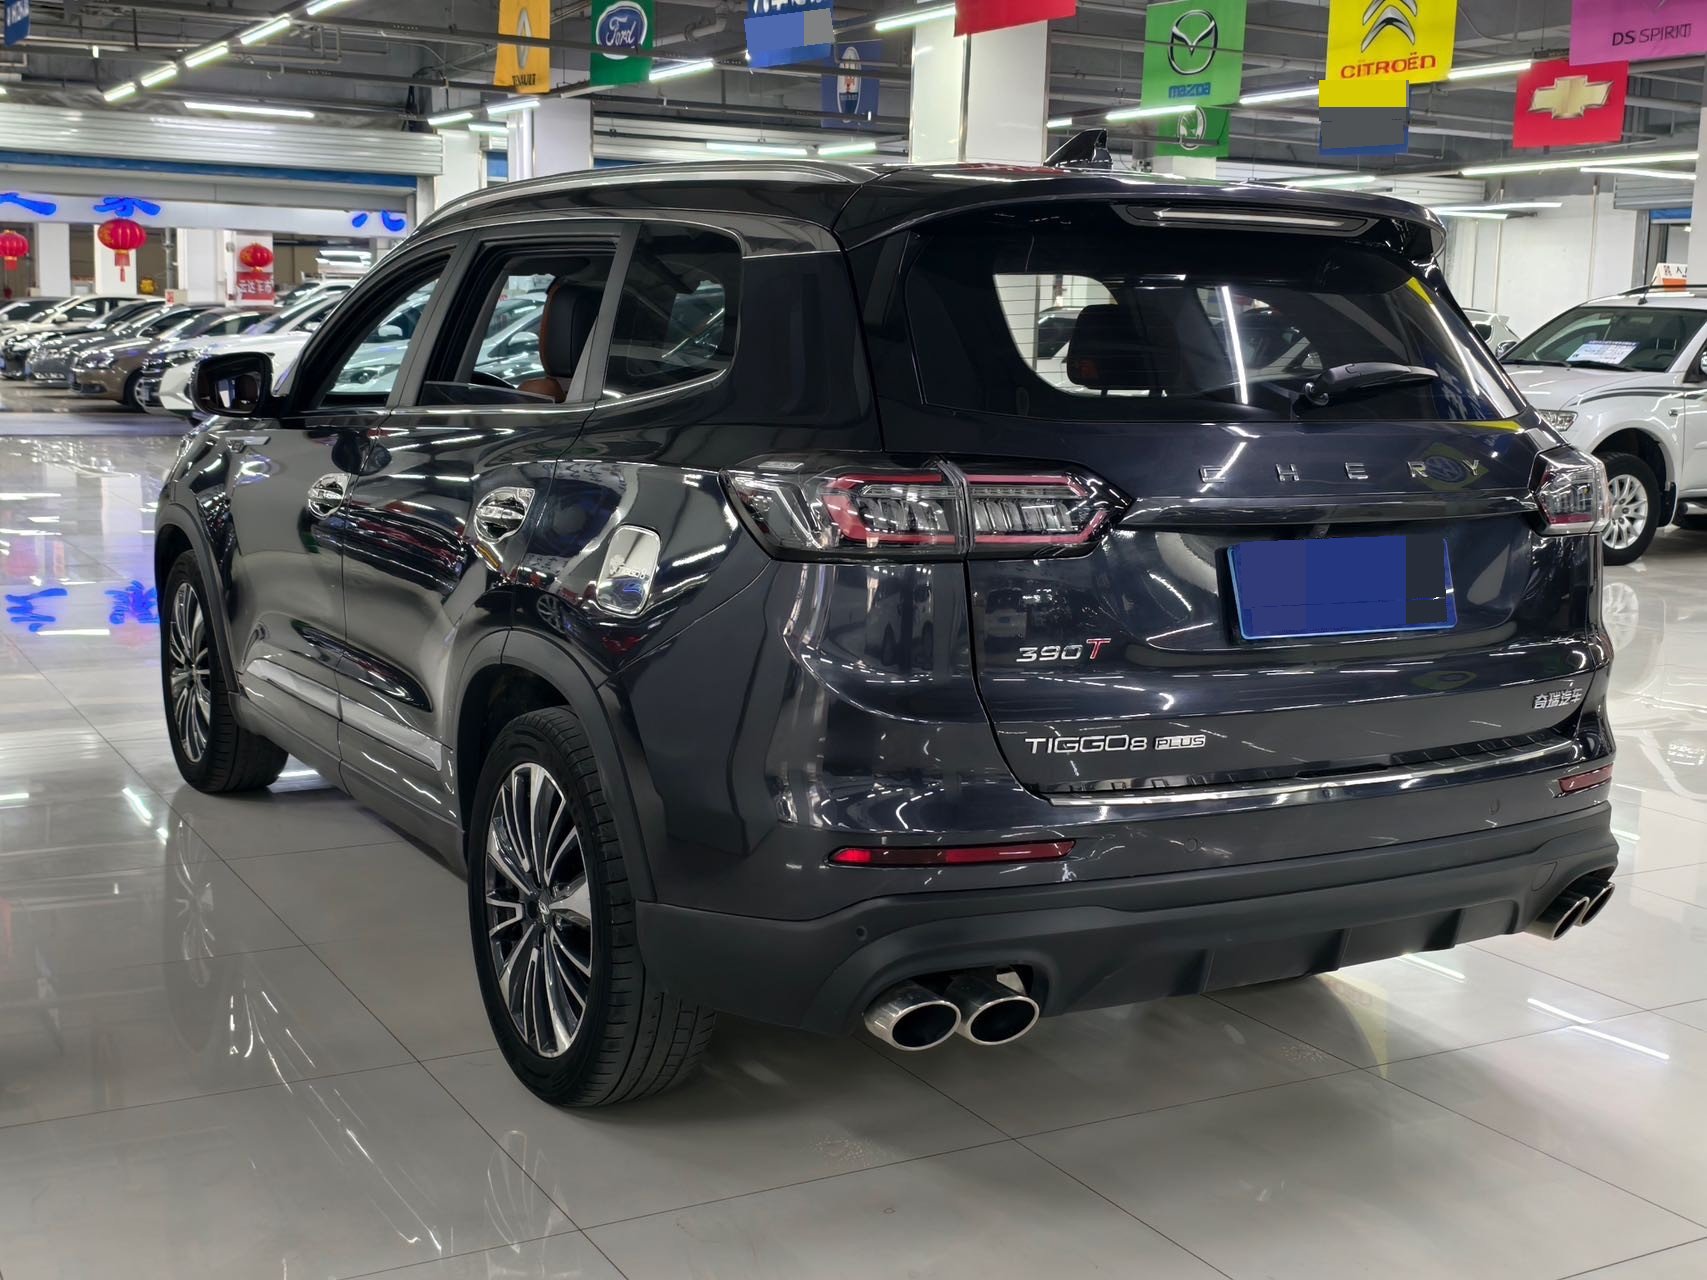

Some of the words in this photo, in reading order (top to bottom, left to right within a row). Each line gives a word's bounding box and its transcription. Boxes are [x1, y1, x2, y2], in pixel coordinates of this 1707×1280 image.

[605, 16, 636, 47] Ford
[1612, 30, 1636, 46] DS
[1340, 52, 1437, 79] CITROËN
[1199, 459, 1480, 483] CHERY
[1015, 637, 1112, 663] 390T
[1532, 687, 1583, 709] 奇瑞汽车
[1154, 734, 1206, 750] PLUS
